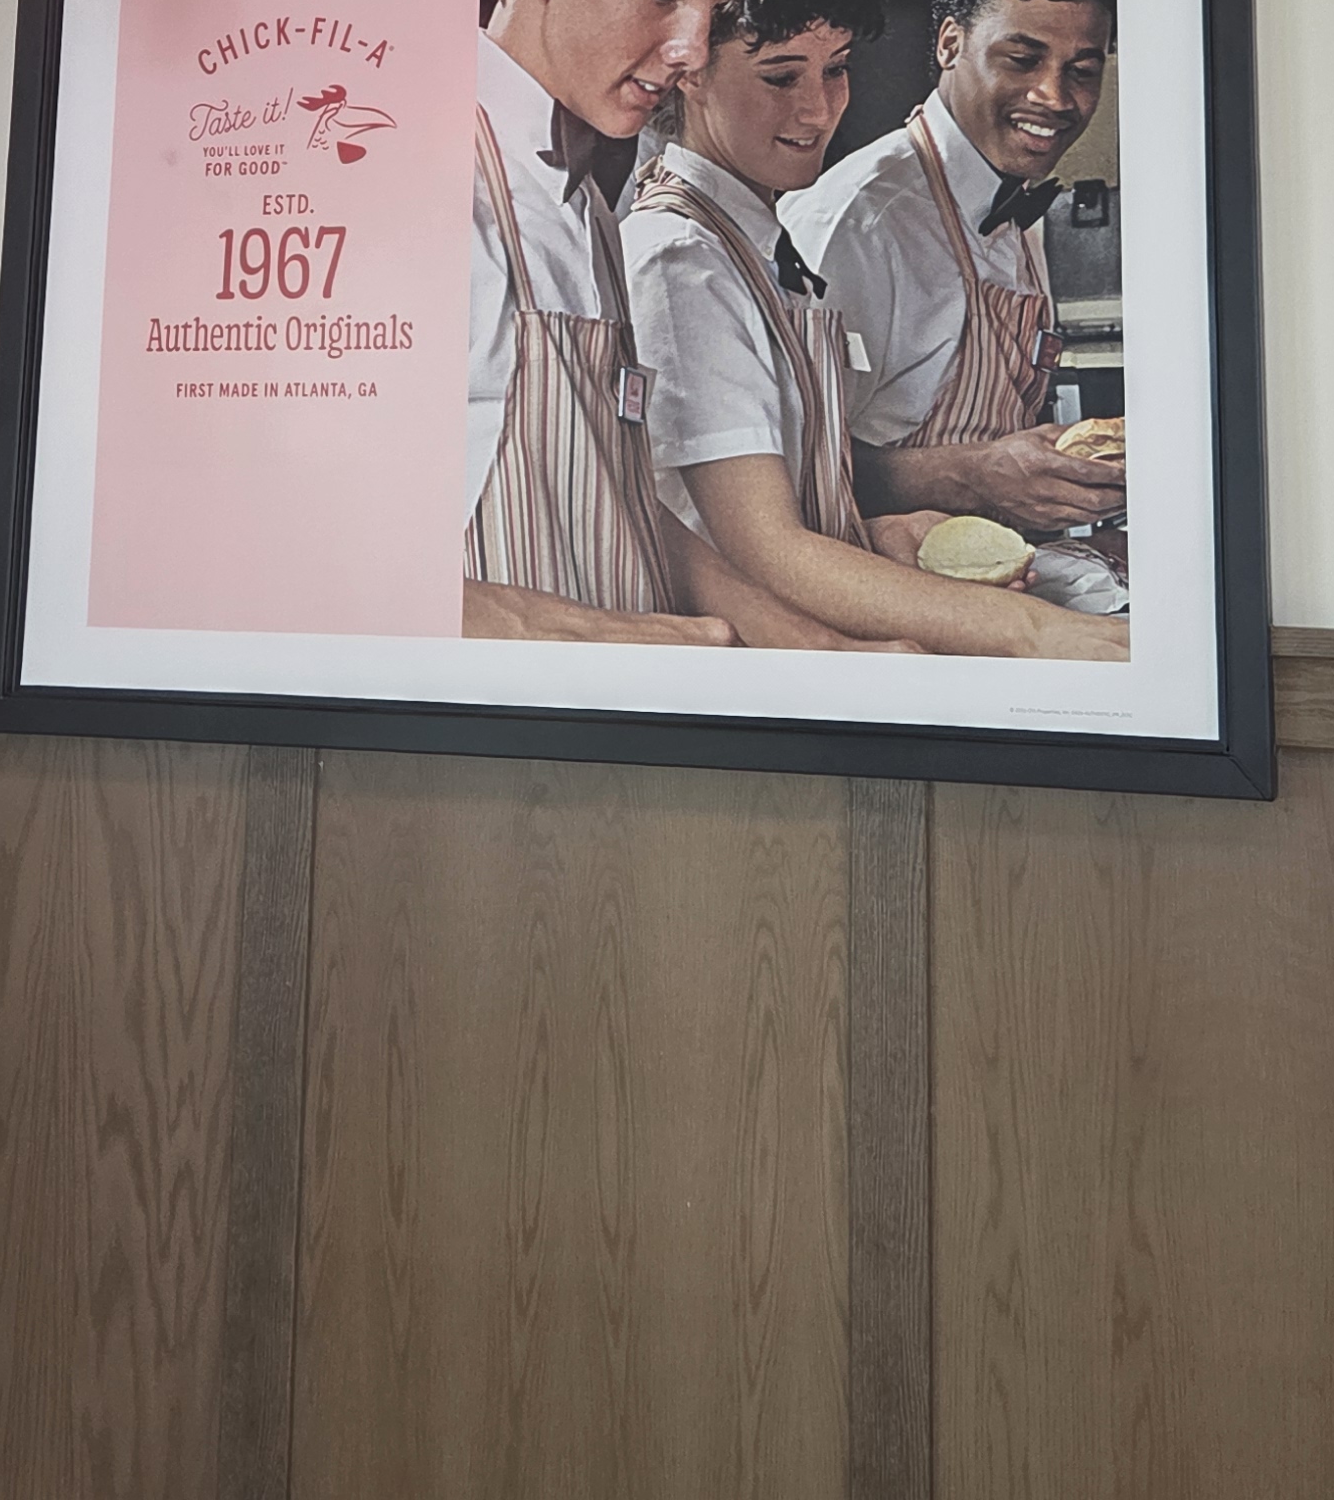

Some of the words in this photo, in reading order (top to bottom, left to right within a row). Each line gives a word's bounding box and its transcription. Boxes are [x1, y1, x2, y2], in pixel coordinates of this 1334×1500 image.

[197, 16, 388, 75] CHICK-FIL-A
[188, 99, 257, 141] Taste
[262, 87, 294, 124] it!
[202, 146, 240, 157] YOU'LL
[244, 145, 271, 156] LOVE
[275, 144, 285, 155] IT
[205, 162, 233, 177] FOR
[238, 160, 281, 176] GOOD
[262, 193, 315, 216] ESTD.
[215, 225, 347, 300] 1967
[145, 315, 278, 353] Authentic
[285, 313, 414, 360] Originals
[176, 382, 214, 398] FIRST
[219, 382, 259, 398] MADE
[264, 382, 279, 398] IN
[284, 382, 352, 399] ATLANTA,
[358, 382, 378, 398] GA
